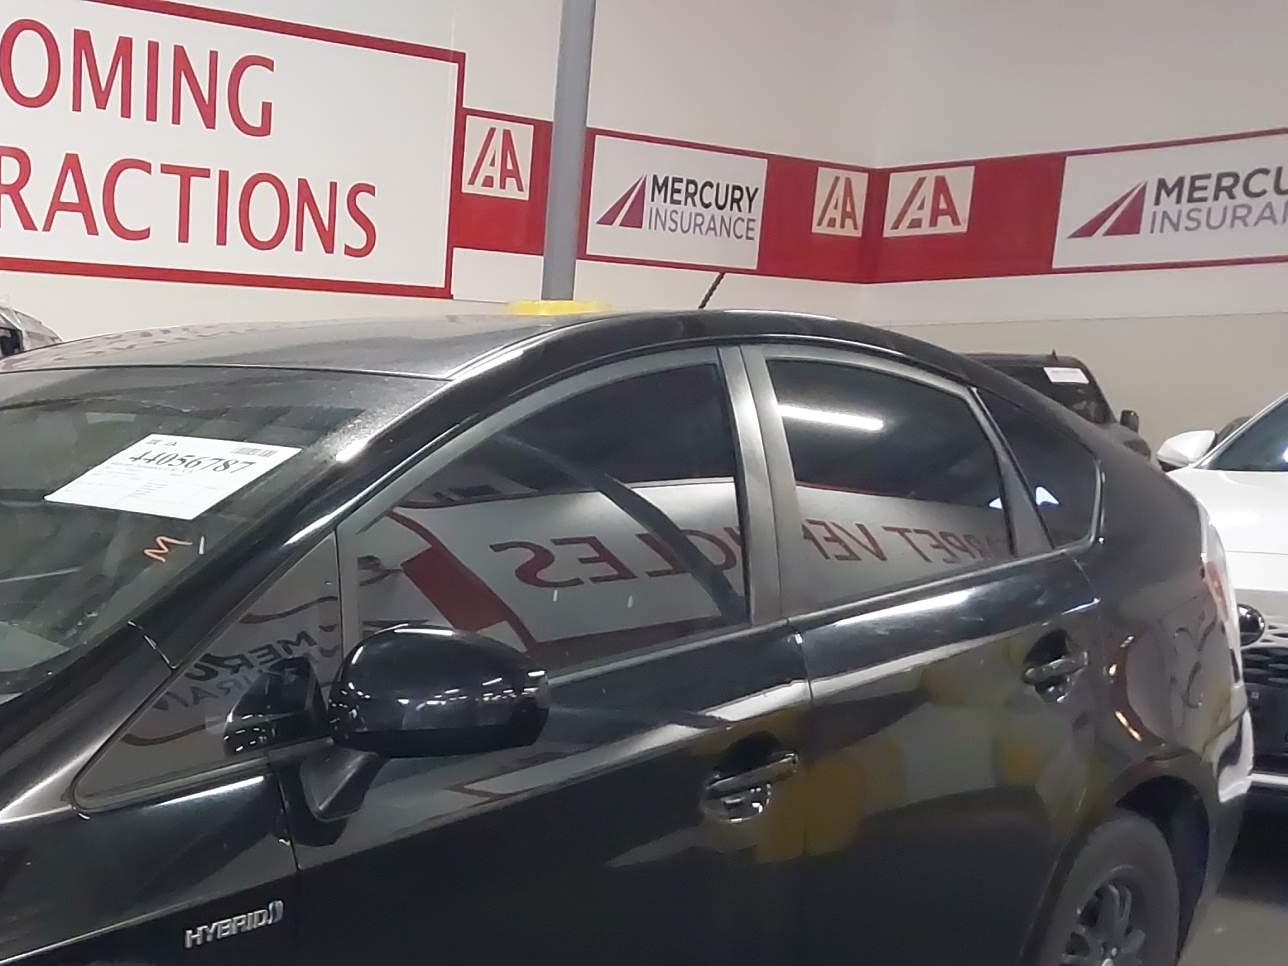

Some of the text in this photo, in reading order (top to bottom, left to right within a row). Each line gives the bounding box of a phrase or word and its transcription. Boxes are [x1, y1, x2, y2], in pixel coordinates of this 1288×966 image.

[650, 174, 759, 213] MERCURY
[648, 207, 757, 241] INSURANCE
[1149, 201, 1288, 235] INSURA
[128, 449, 257, 474] 44056787
[184, 908, 270, 949] HYBRID
